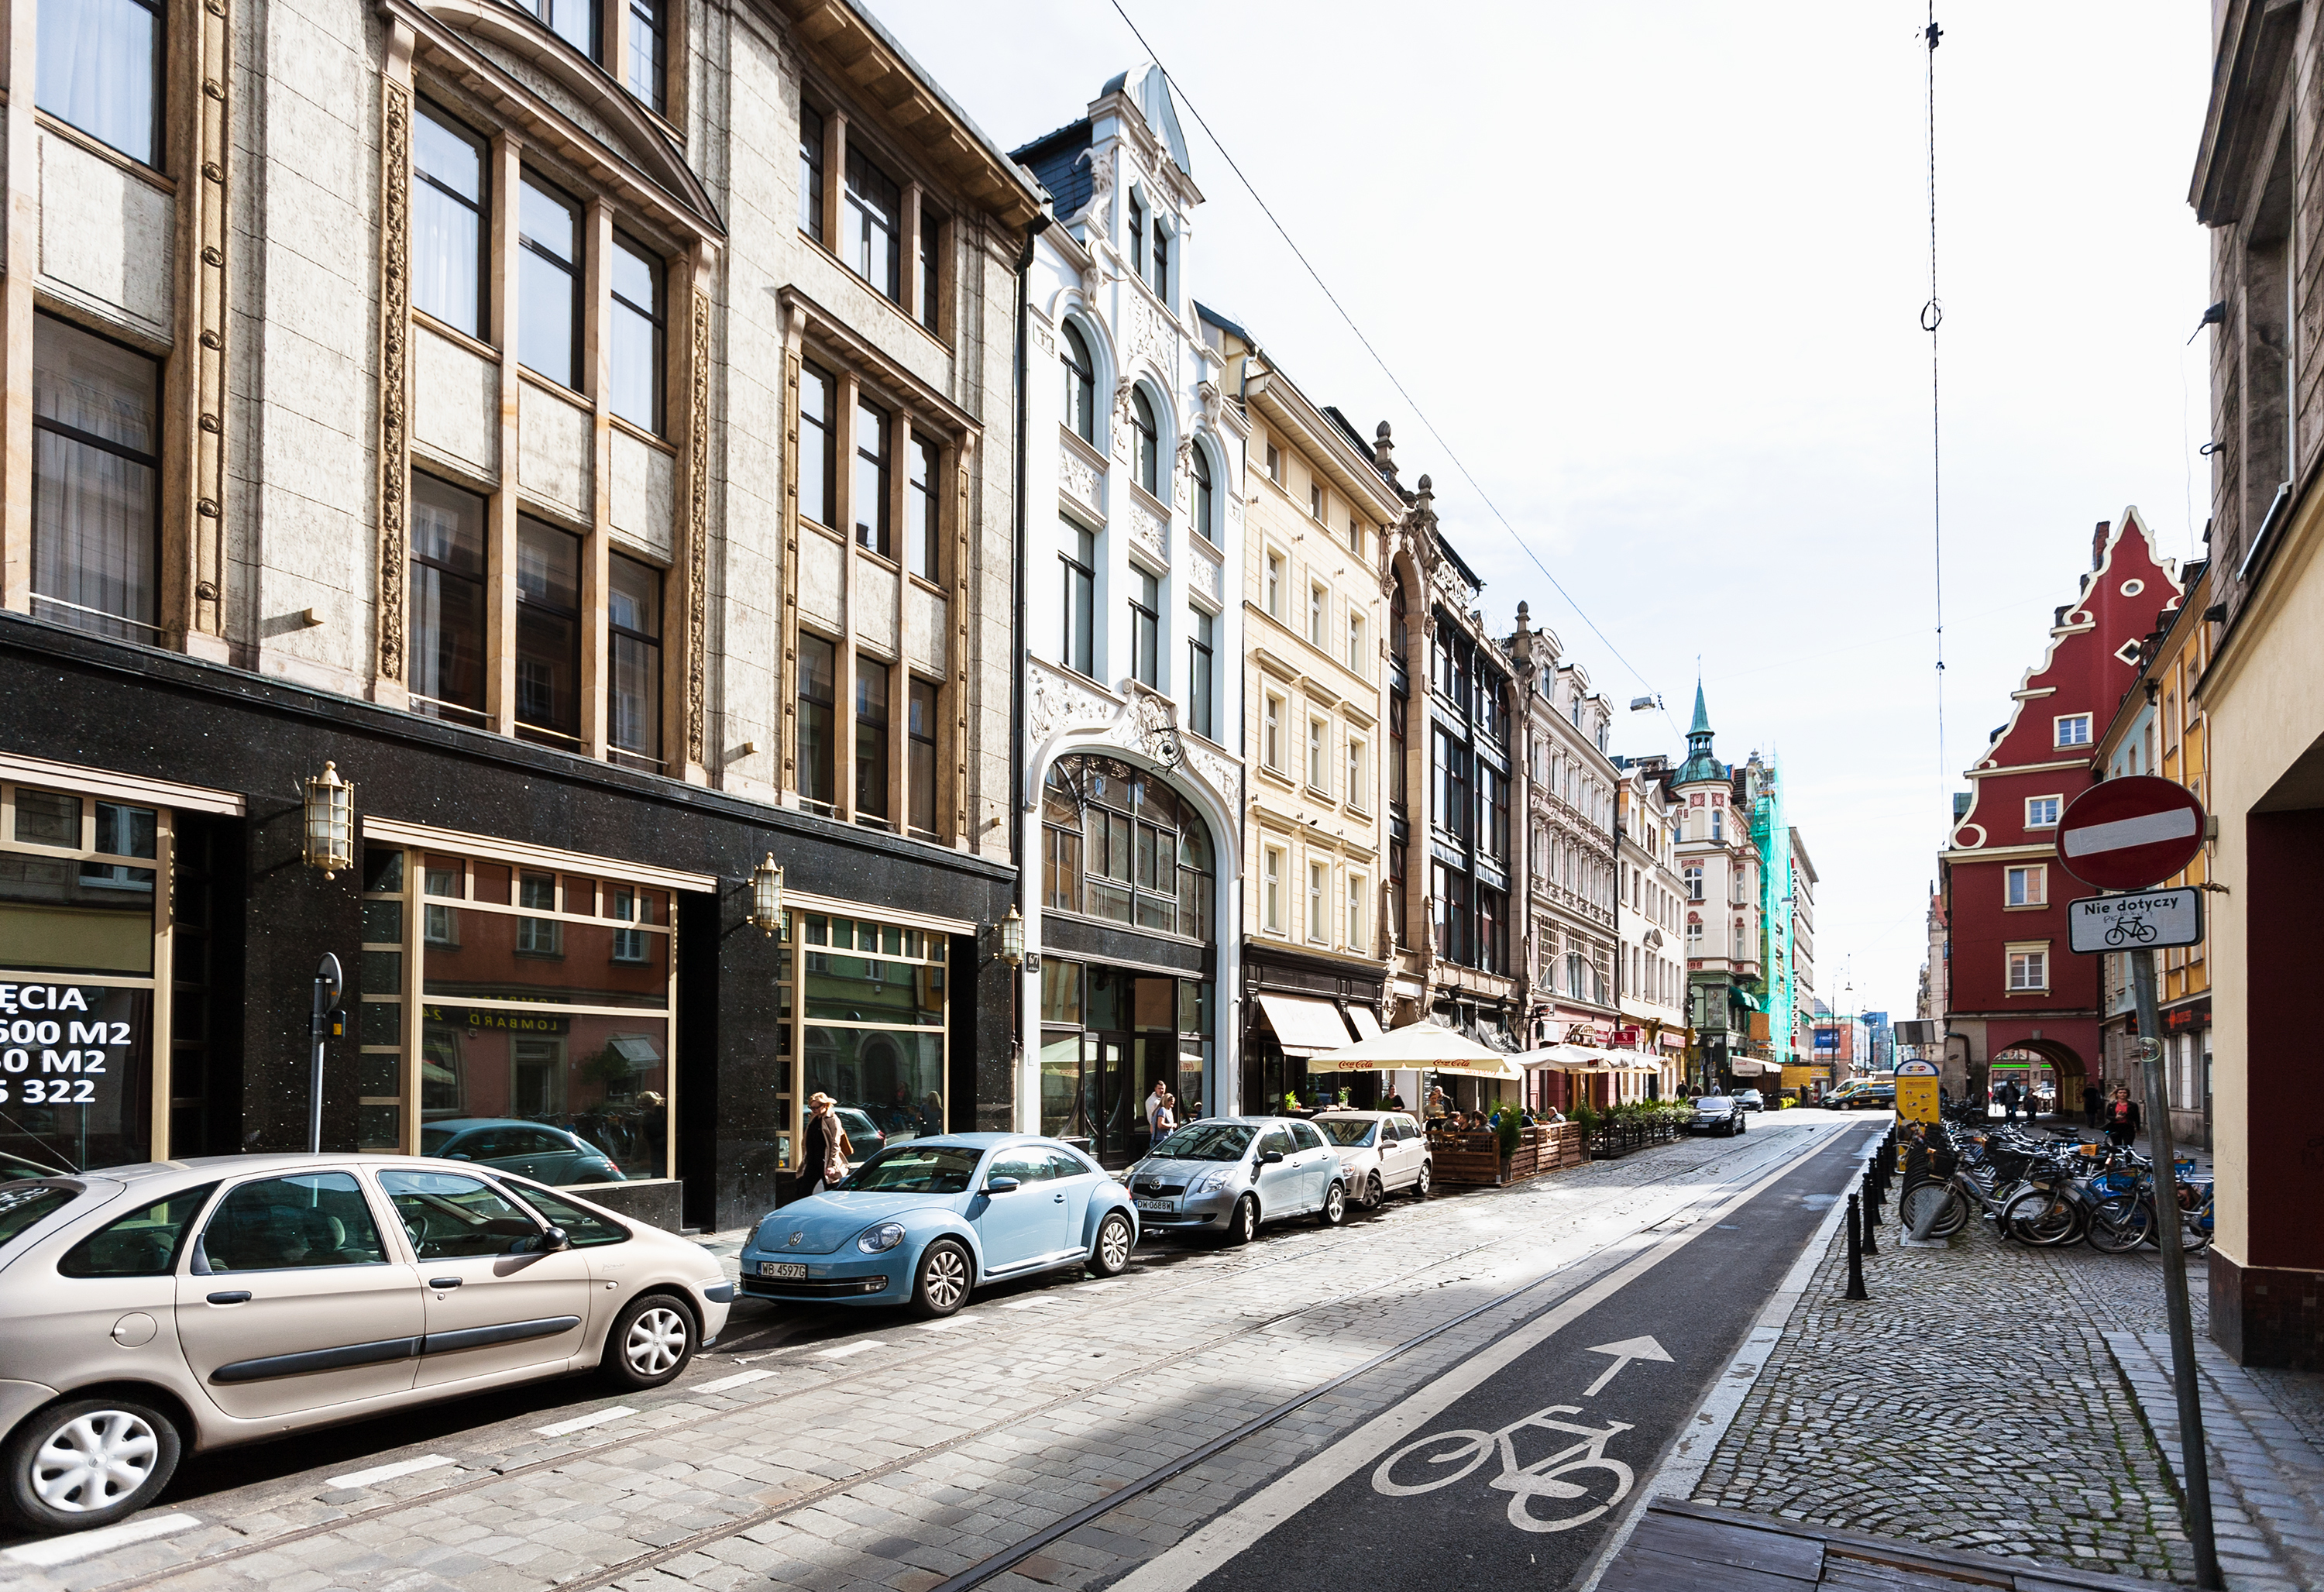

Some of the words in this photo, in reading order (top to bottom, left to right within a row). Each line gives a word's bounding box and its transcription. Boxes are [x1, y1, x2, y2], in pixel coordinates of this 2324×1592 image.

[2085, 903, 2110, 916] Nie
[2117, 896, 2178, 912] dotyczy
[0, 985, 88, 1015] ĘCIA
[70, 1021, 132, 1045] M2
[43, 1049, 106, 1073] M2
[22, 1079, 95, 1103] 322
[762, 1264, 775, 1275] WB
[777, 1264, 805, 1277] 4597G
